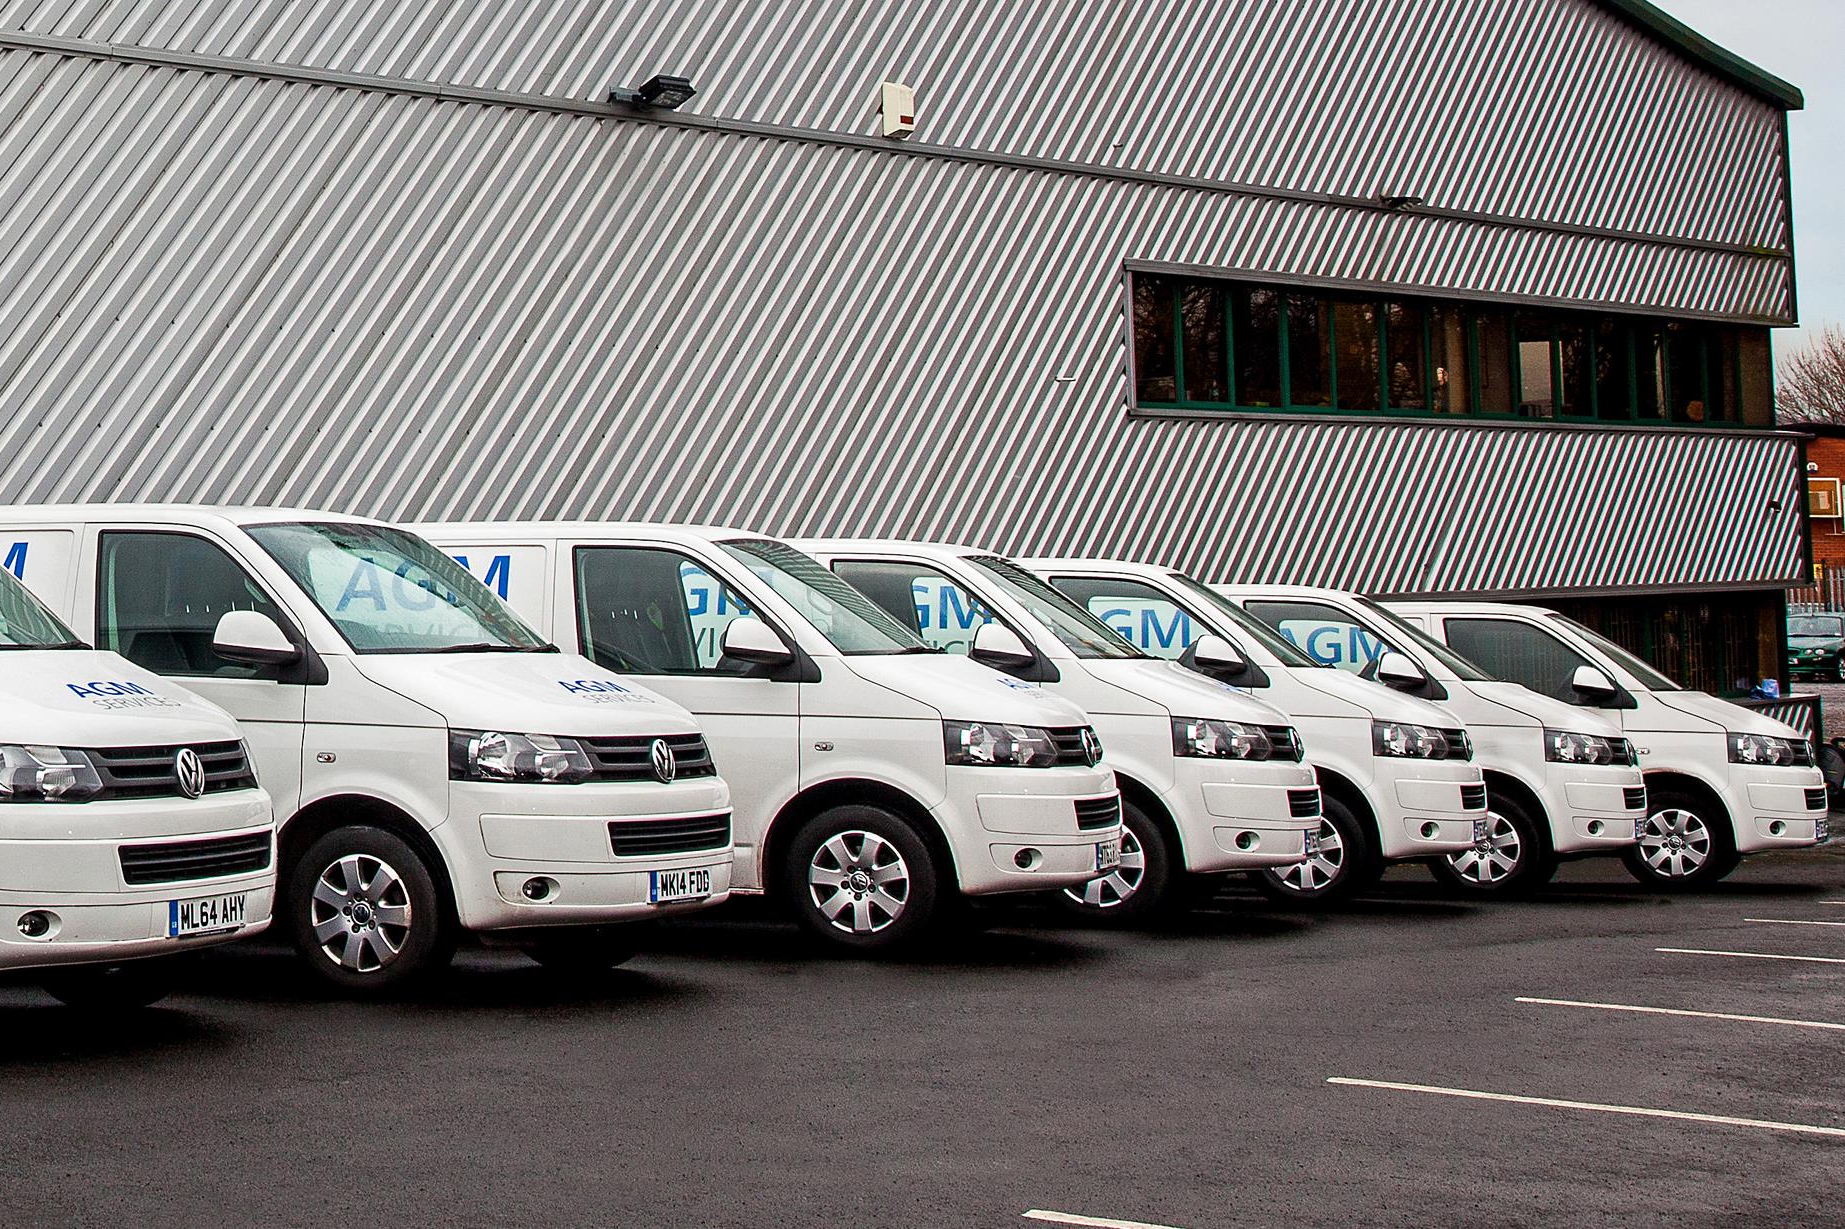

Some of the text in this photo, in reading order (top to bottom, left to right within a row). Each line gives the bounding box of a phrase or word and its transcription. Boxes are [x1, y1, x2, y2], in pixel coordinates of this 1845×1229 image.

[1100, 608, 1190, 649] GM
[66, 681, 154, 698] AGM
[558, 680, 631, 694] AGM
[661, 872, 686, 897] MK14
[181, 895, 245, 930] ML64 AHY
